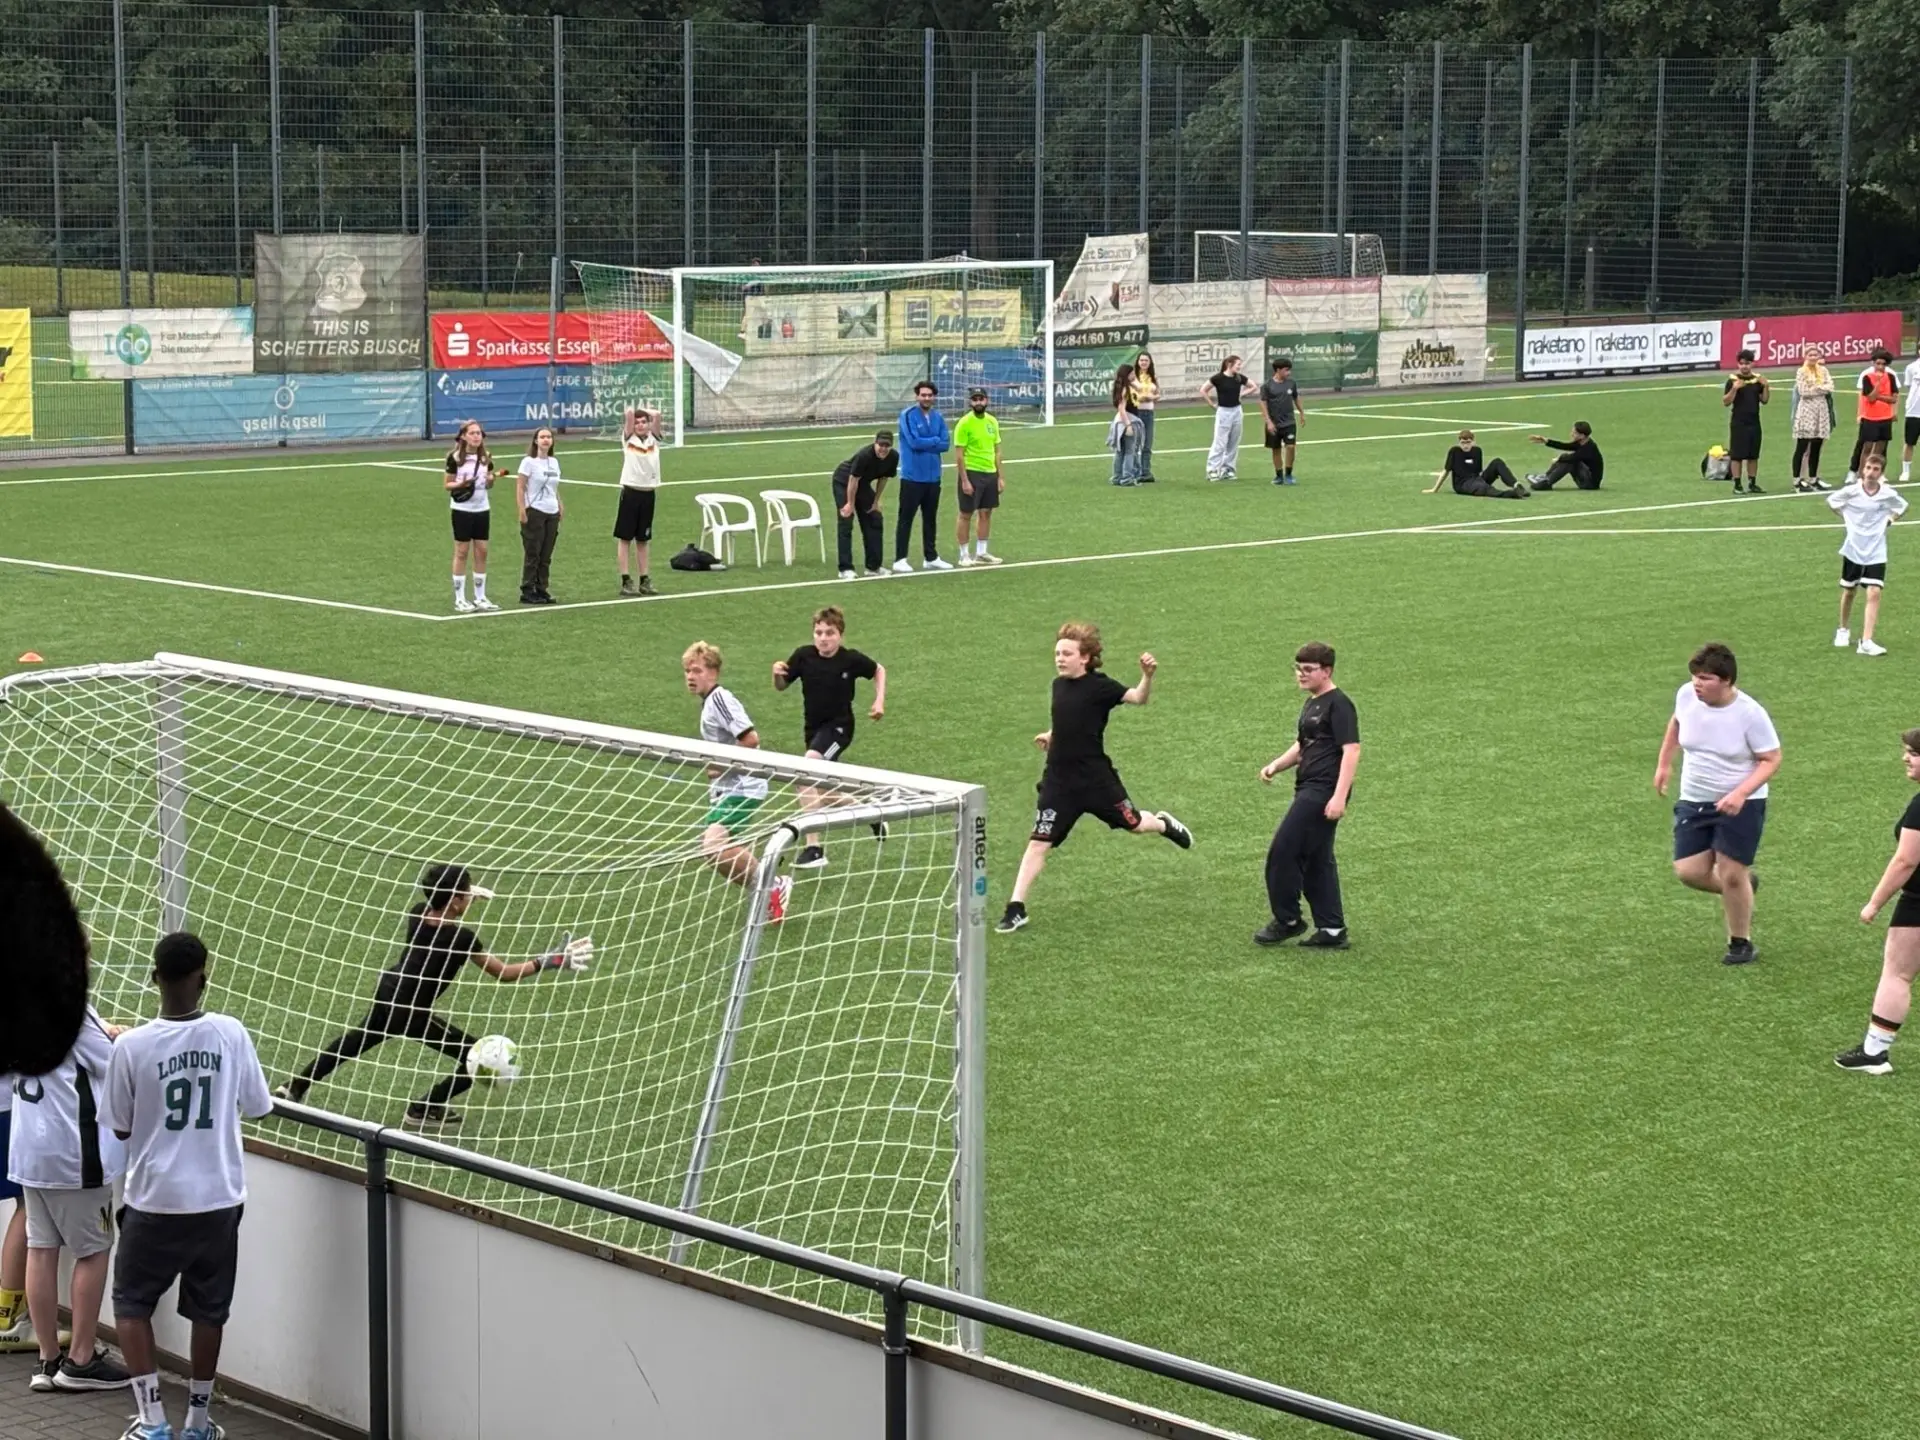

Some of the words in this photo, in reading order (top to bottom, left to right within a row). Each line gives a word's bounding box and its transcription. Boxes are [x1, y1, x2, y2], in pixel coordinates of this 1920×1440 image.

[313, 320, 349, 336] THIS
[353, 320, 370, 335] IS
[1107, 331, 1121, 343] 79
[1123, 329, 1145, 341] 477
[120, 332, 149, 355] do
[260, 340, 360, 357] SCHETTERS
[363, 338, 421, 355] BUSCH
[476, 339, 551, 359] Sparkasse
[557, 337, 600, 355] Essen
[1527, 335, 1586, 354] naketano
[1595, 332, 1649, 351] naketano
[1658, 329, 1713, 349] naketano
[1768, 337, 1841, 364] Sparksse
[456, 380, 494, 391] Allbau
[243, 417, 279, 438] gsell
[280, 416, 291, 428] &
[292, 413, 326, 436] gsell
[157, 1050, 222, 1080] LONDON
[165, 1076, 213, 1131] 91
